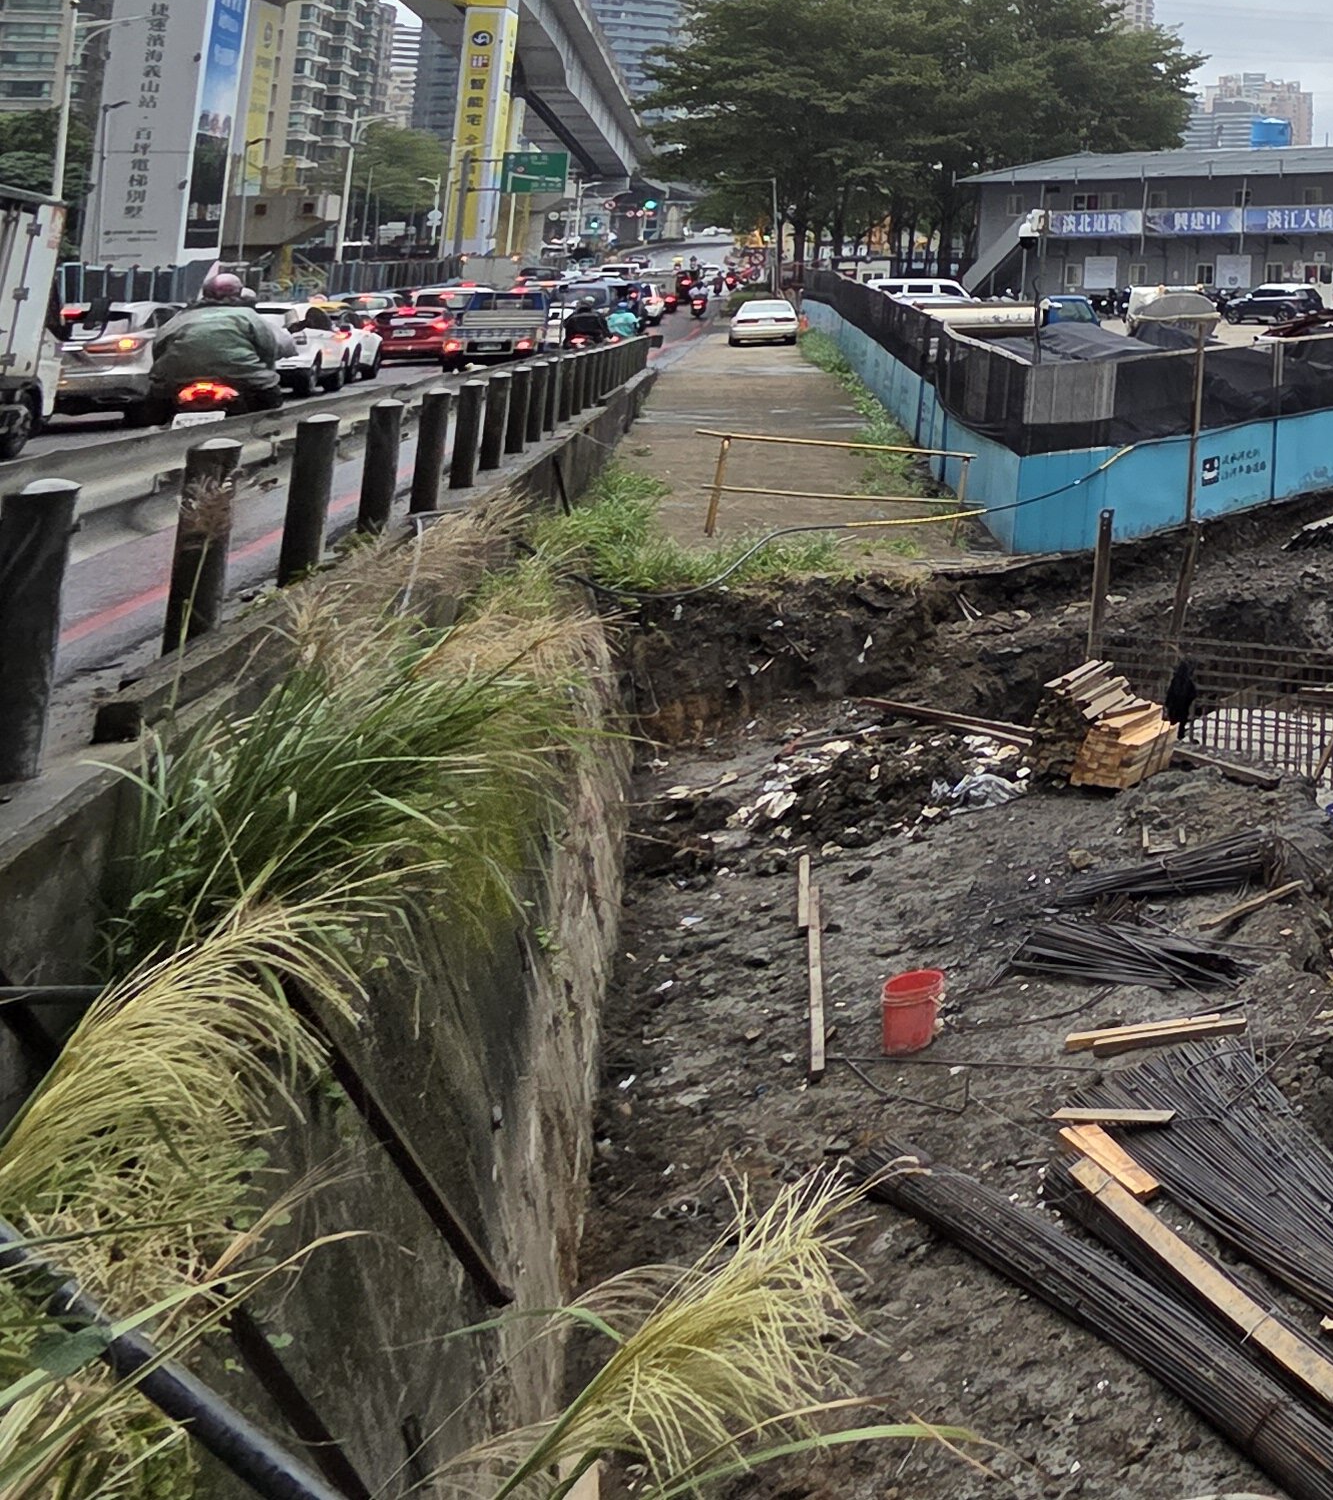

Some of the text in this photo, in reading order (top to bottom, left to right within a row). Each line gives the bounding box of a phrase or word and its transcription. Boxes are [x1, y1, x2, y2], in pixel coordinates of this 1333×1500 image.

[1063, 213, 1122, 233] 淡北道路
[1173, 211, 1221, 231] 興建中
[1266, 208, 1333, 230] 淡江大橋
